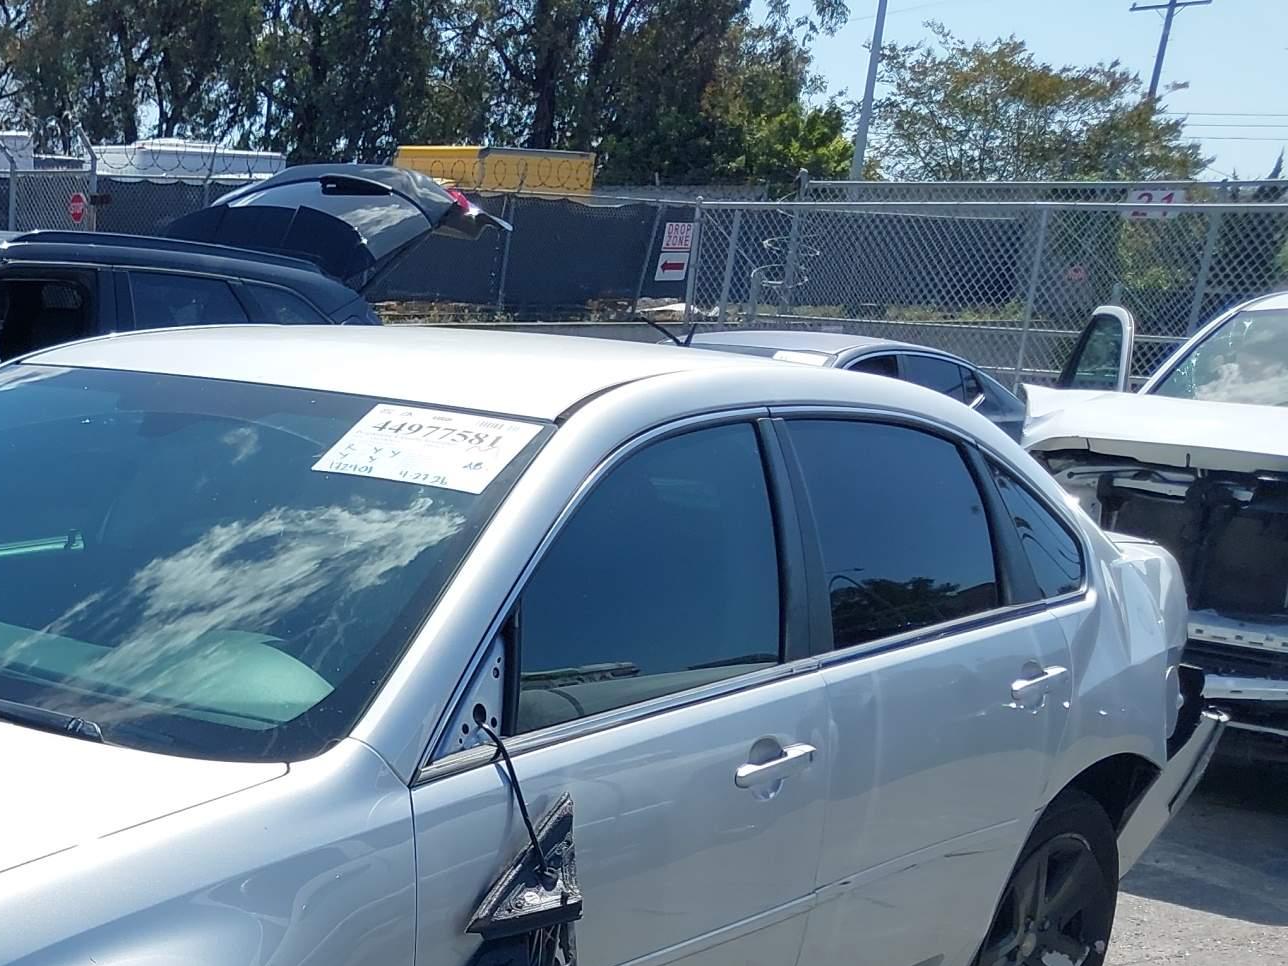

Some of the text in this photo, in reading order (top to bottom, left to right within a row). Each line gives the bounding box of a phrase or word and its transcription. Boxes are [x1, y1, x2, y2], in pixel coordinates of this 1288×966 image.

[668, 223, 692, 236] DROP
[666, 235, 690, 247] ZONE
[372, 420, 503, 449] 44977581
